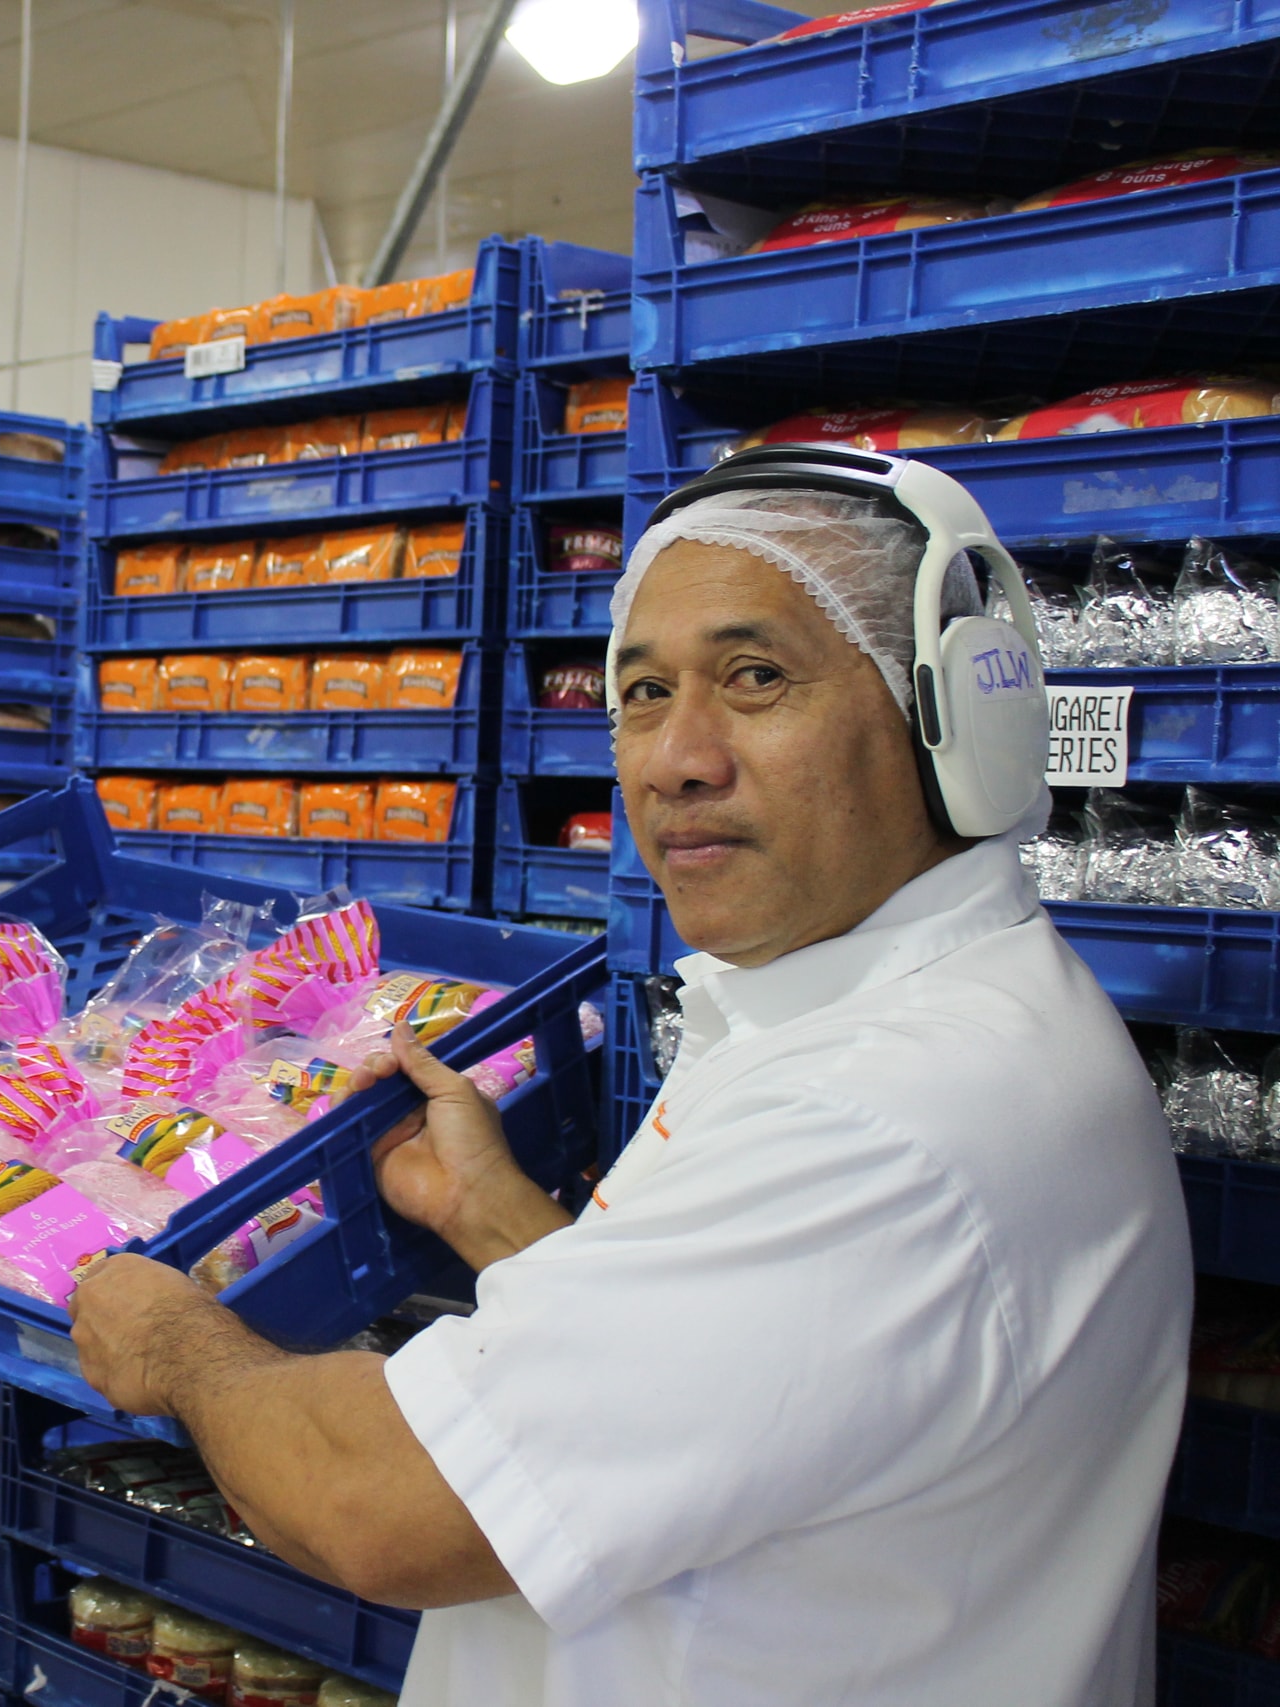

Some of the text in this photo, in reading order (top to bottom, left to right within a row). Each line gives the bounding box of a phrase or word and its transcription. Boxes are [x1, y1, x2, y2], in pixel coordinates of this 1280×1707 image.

[30, 1211, 41, 1221] 6
[33, 1217, 58, 1231] ICED
[22, 1212, 88, 1253] FINGER BUNS
